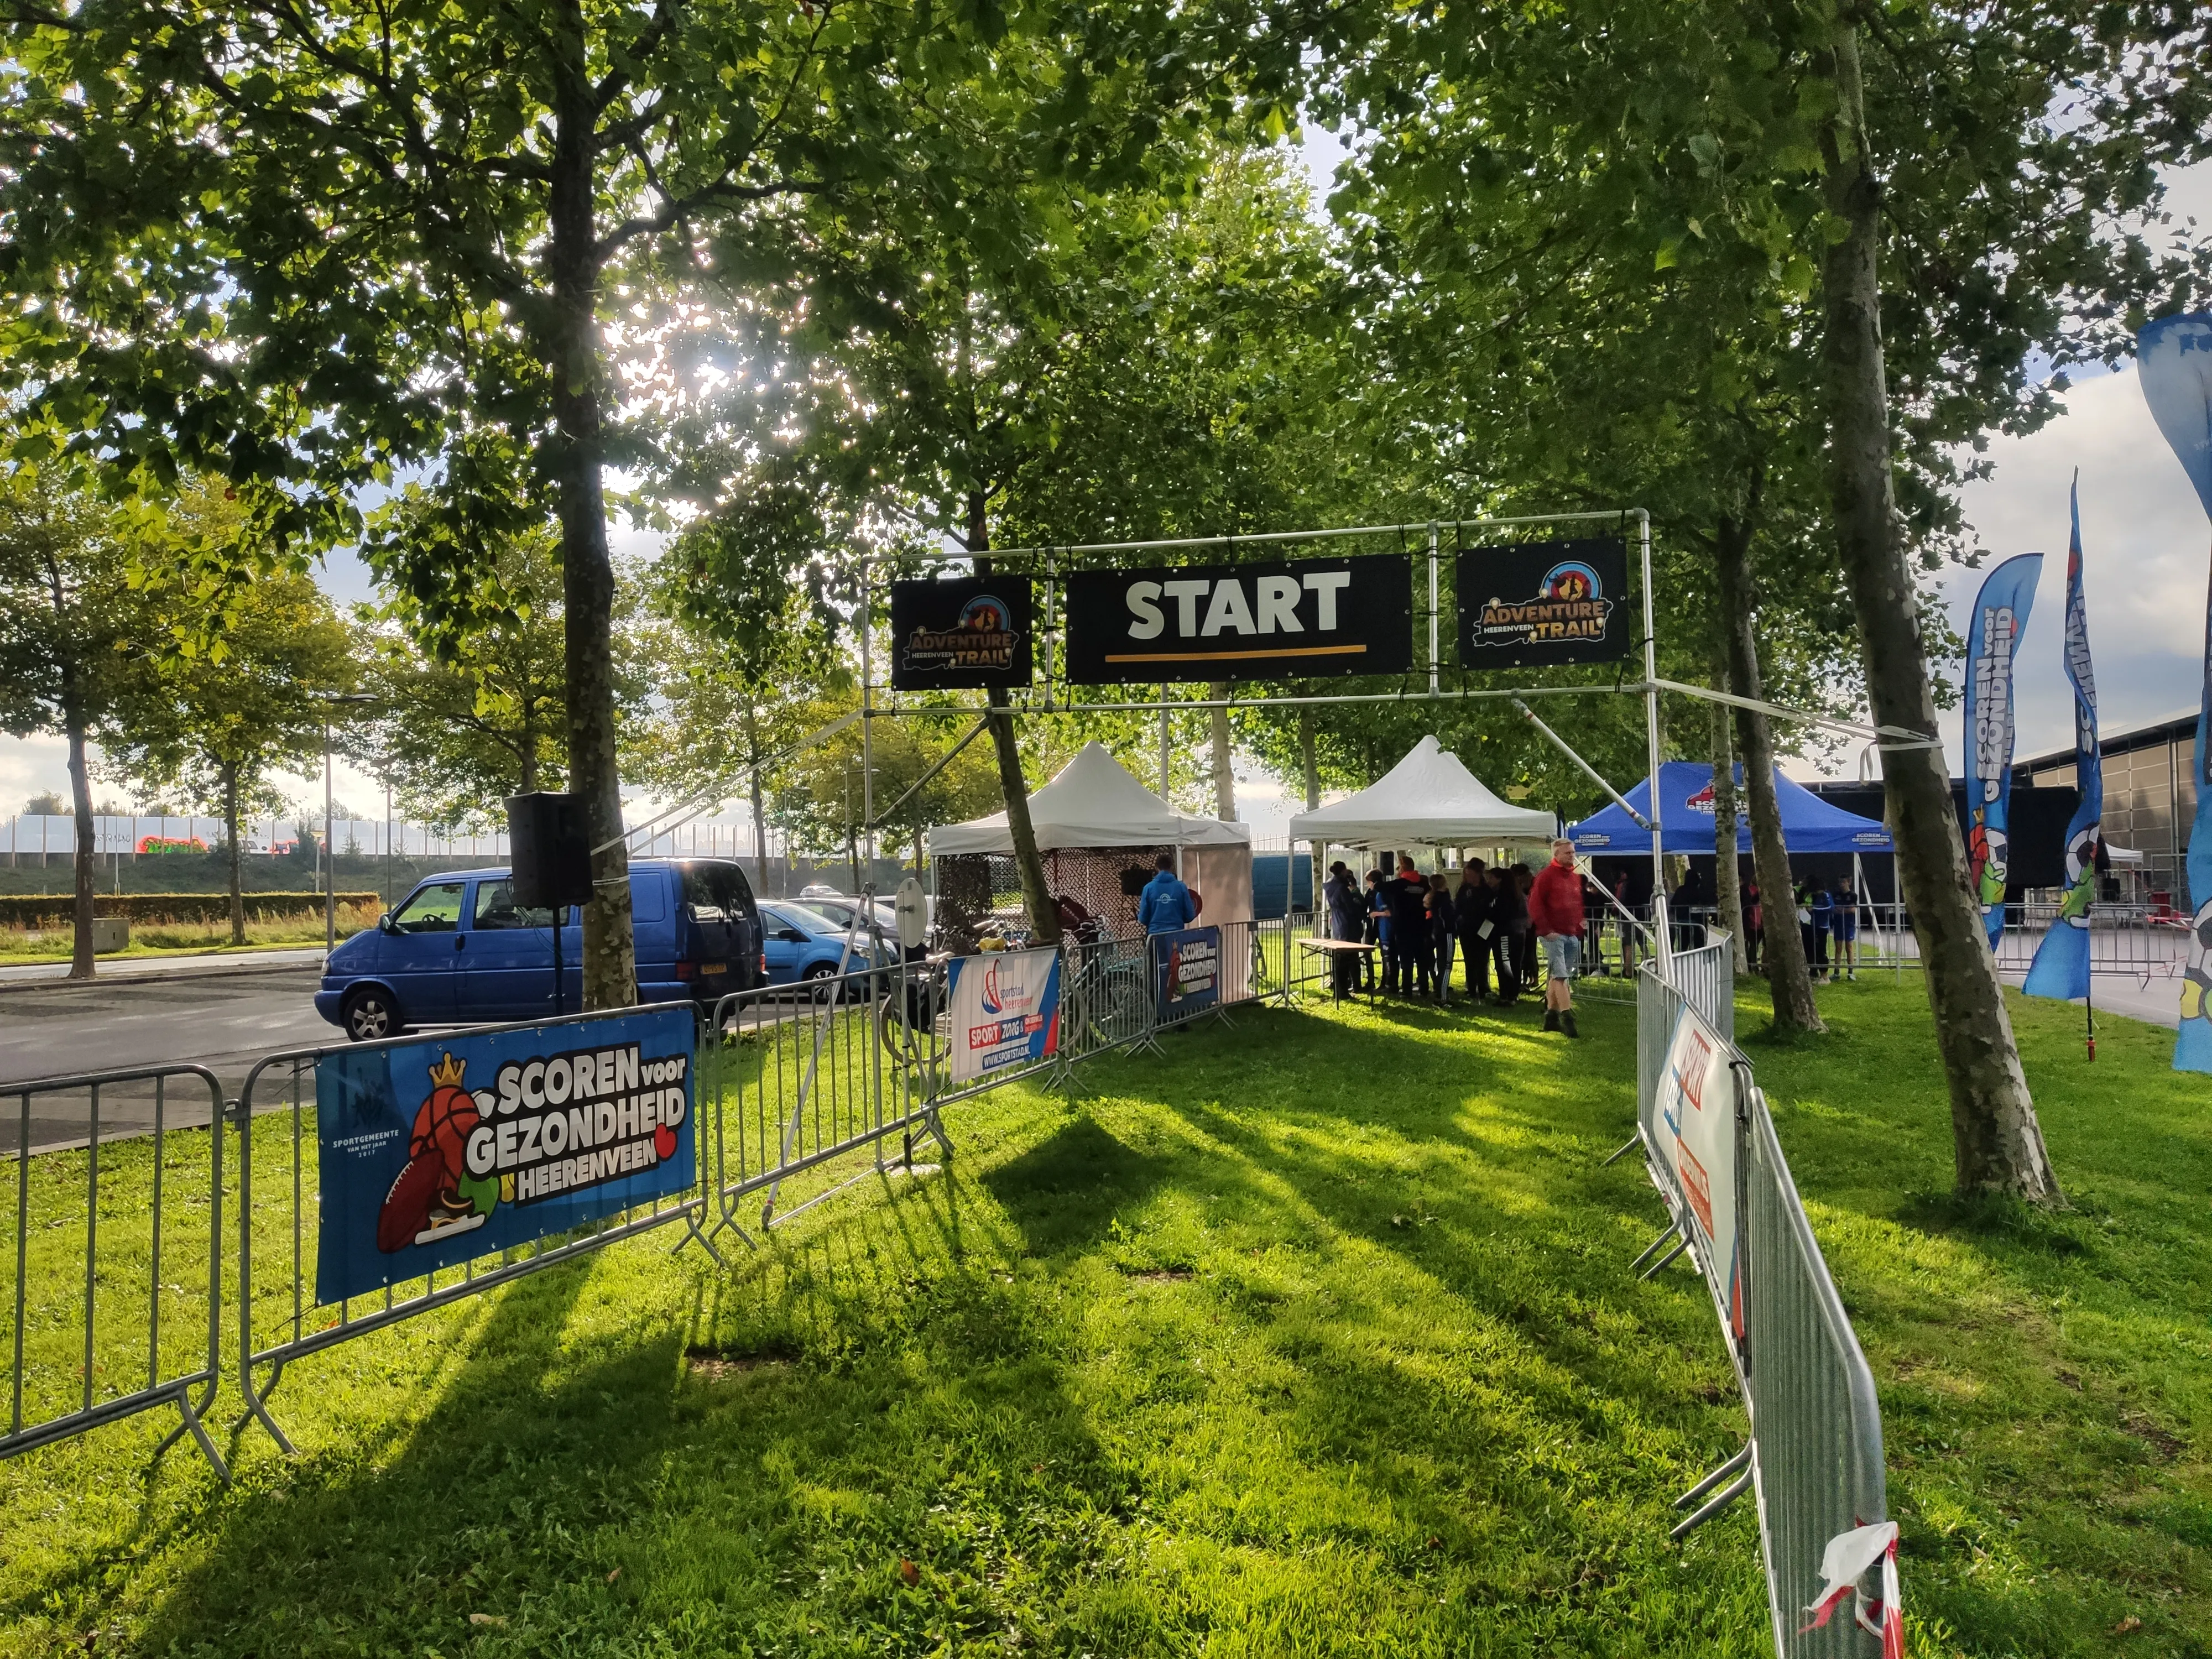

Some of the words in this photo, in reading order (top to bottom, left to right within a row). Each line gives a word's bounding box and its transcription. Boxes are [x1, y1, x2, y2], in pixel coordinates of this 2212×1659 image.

[1126, 571, 1350, 640] START
[1483, 601, 1604, 625] ADVENTURE
[911, 633, 1012, 650] ADVENTURE
[1484, 624, 1534, 634] HEERENVEEN
[1536, 620, 1600, 639] TRAIL
[956, 650, 1008, 664] TRAIL
[1976, 658, 1992, 779] SCOREN
[1985, 608, 1995, 655] voor
[1985, 608, 2013, 802] GEZONDHEID
[1183, 941, 1207, 962] SCOREN
[1500, 936, 1510, 961] PUMA
[1178, 958, 1216, 982] GEZONDHEID
[1000, 983, 1024, 1001] sportstad
[971, 1025, 998, 1046] SPORT
[1001, 1020, 1019, 1039] ZORG
[984, 1045, 1031, 1067] WWW.SPORTSTAD.NL
[498, 1047, 639, 1114] SCOREN
[640, 1058, 686, 1086] voor
[1681, 1034, 1710, 1103] SPORT
[333, 1129, 399, 1148] SPORTGEMEENTE
[466, 1087, 685, 1175] GEZONDHEID
[358, 1150, 375, 1158] 2017
[373, 1141, 386, 1149] JAAR
[518, 1138, 657, 1201] HEERENVEEN
